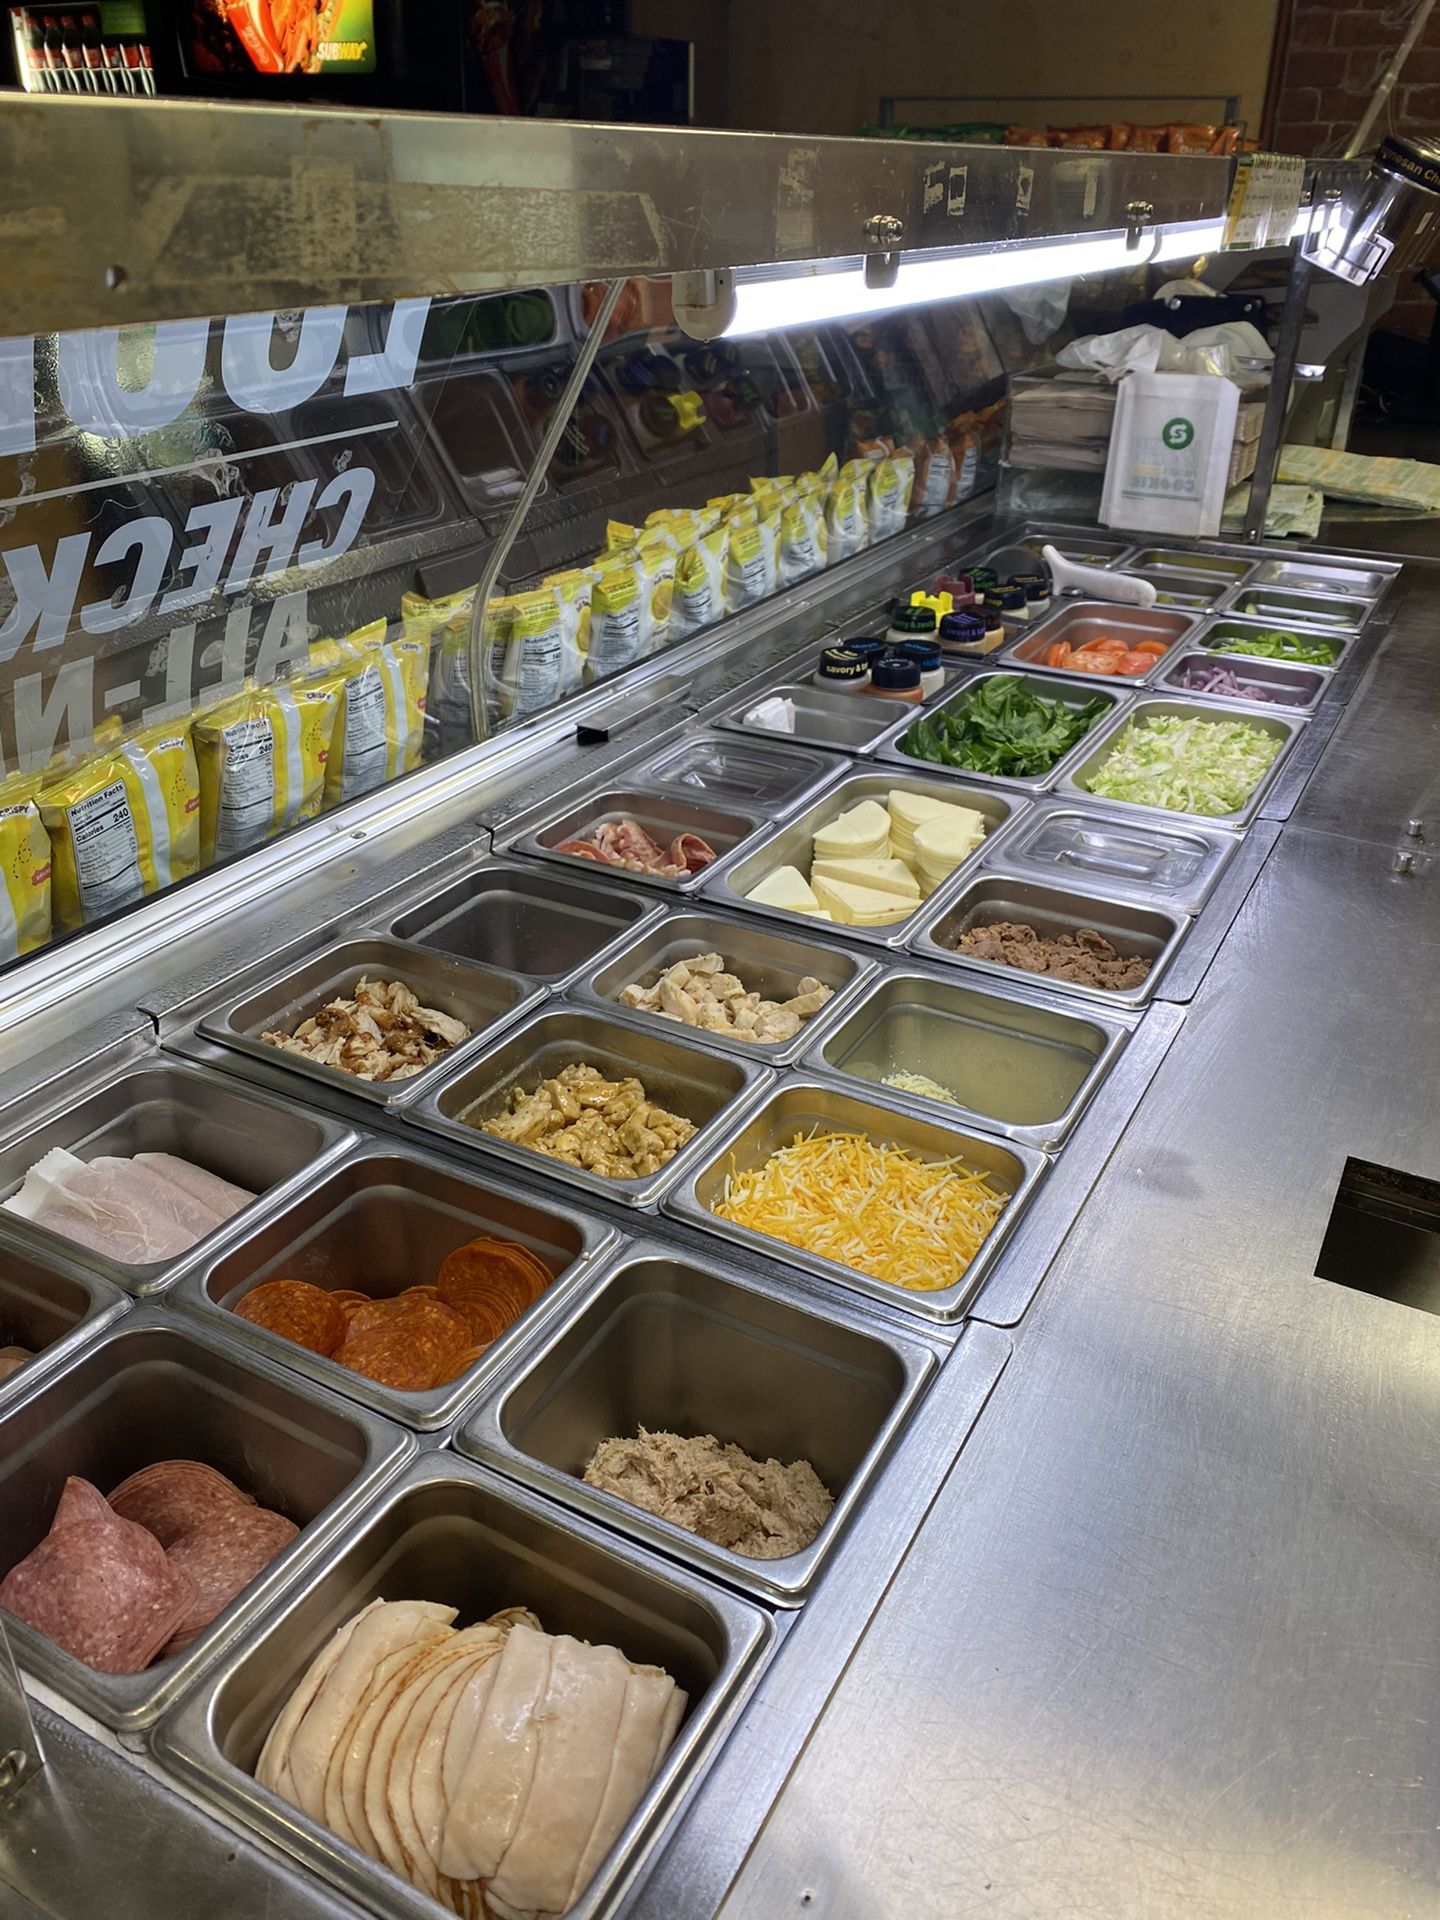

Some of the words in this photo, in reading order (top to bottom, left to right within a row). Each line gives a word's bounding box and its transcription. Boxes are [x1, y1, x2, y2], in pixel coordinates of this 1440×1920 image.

[316, 40, 368, 61] SUBWAY
[826, 665, 855, 676] savory
[258, 742, 274, 755] 240
[70, 796, 104, 817] Nutrition
[103, 784, 124, 799] Facts
[76, 824, 105, 843] Calories
[112, 807, 130, 824] 240
